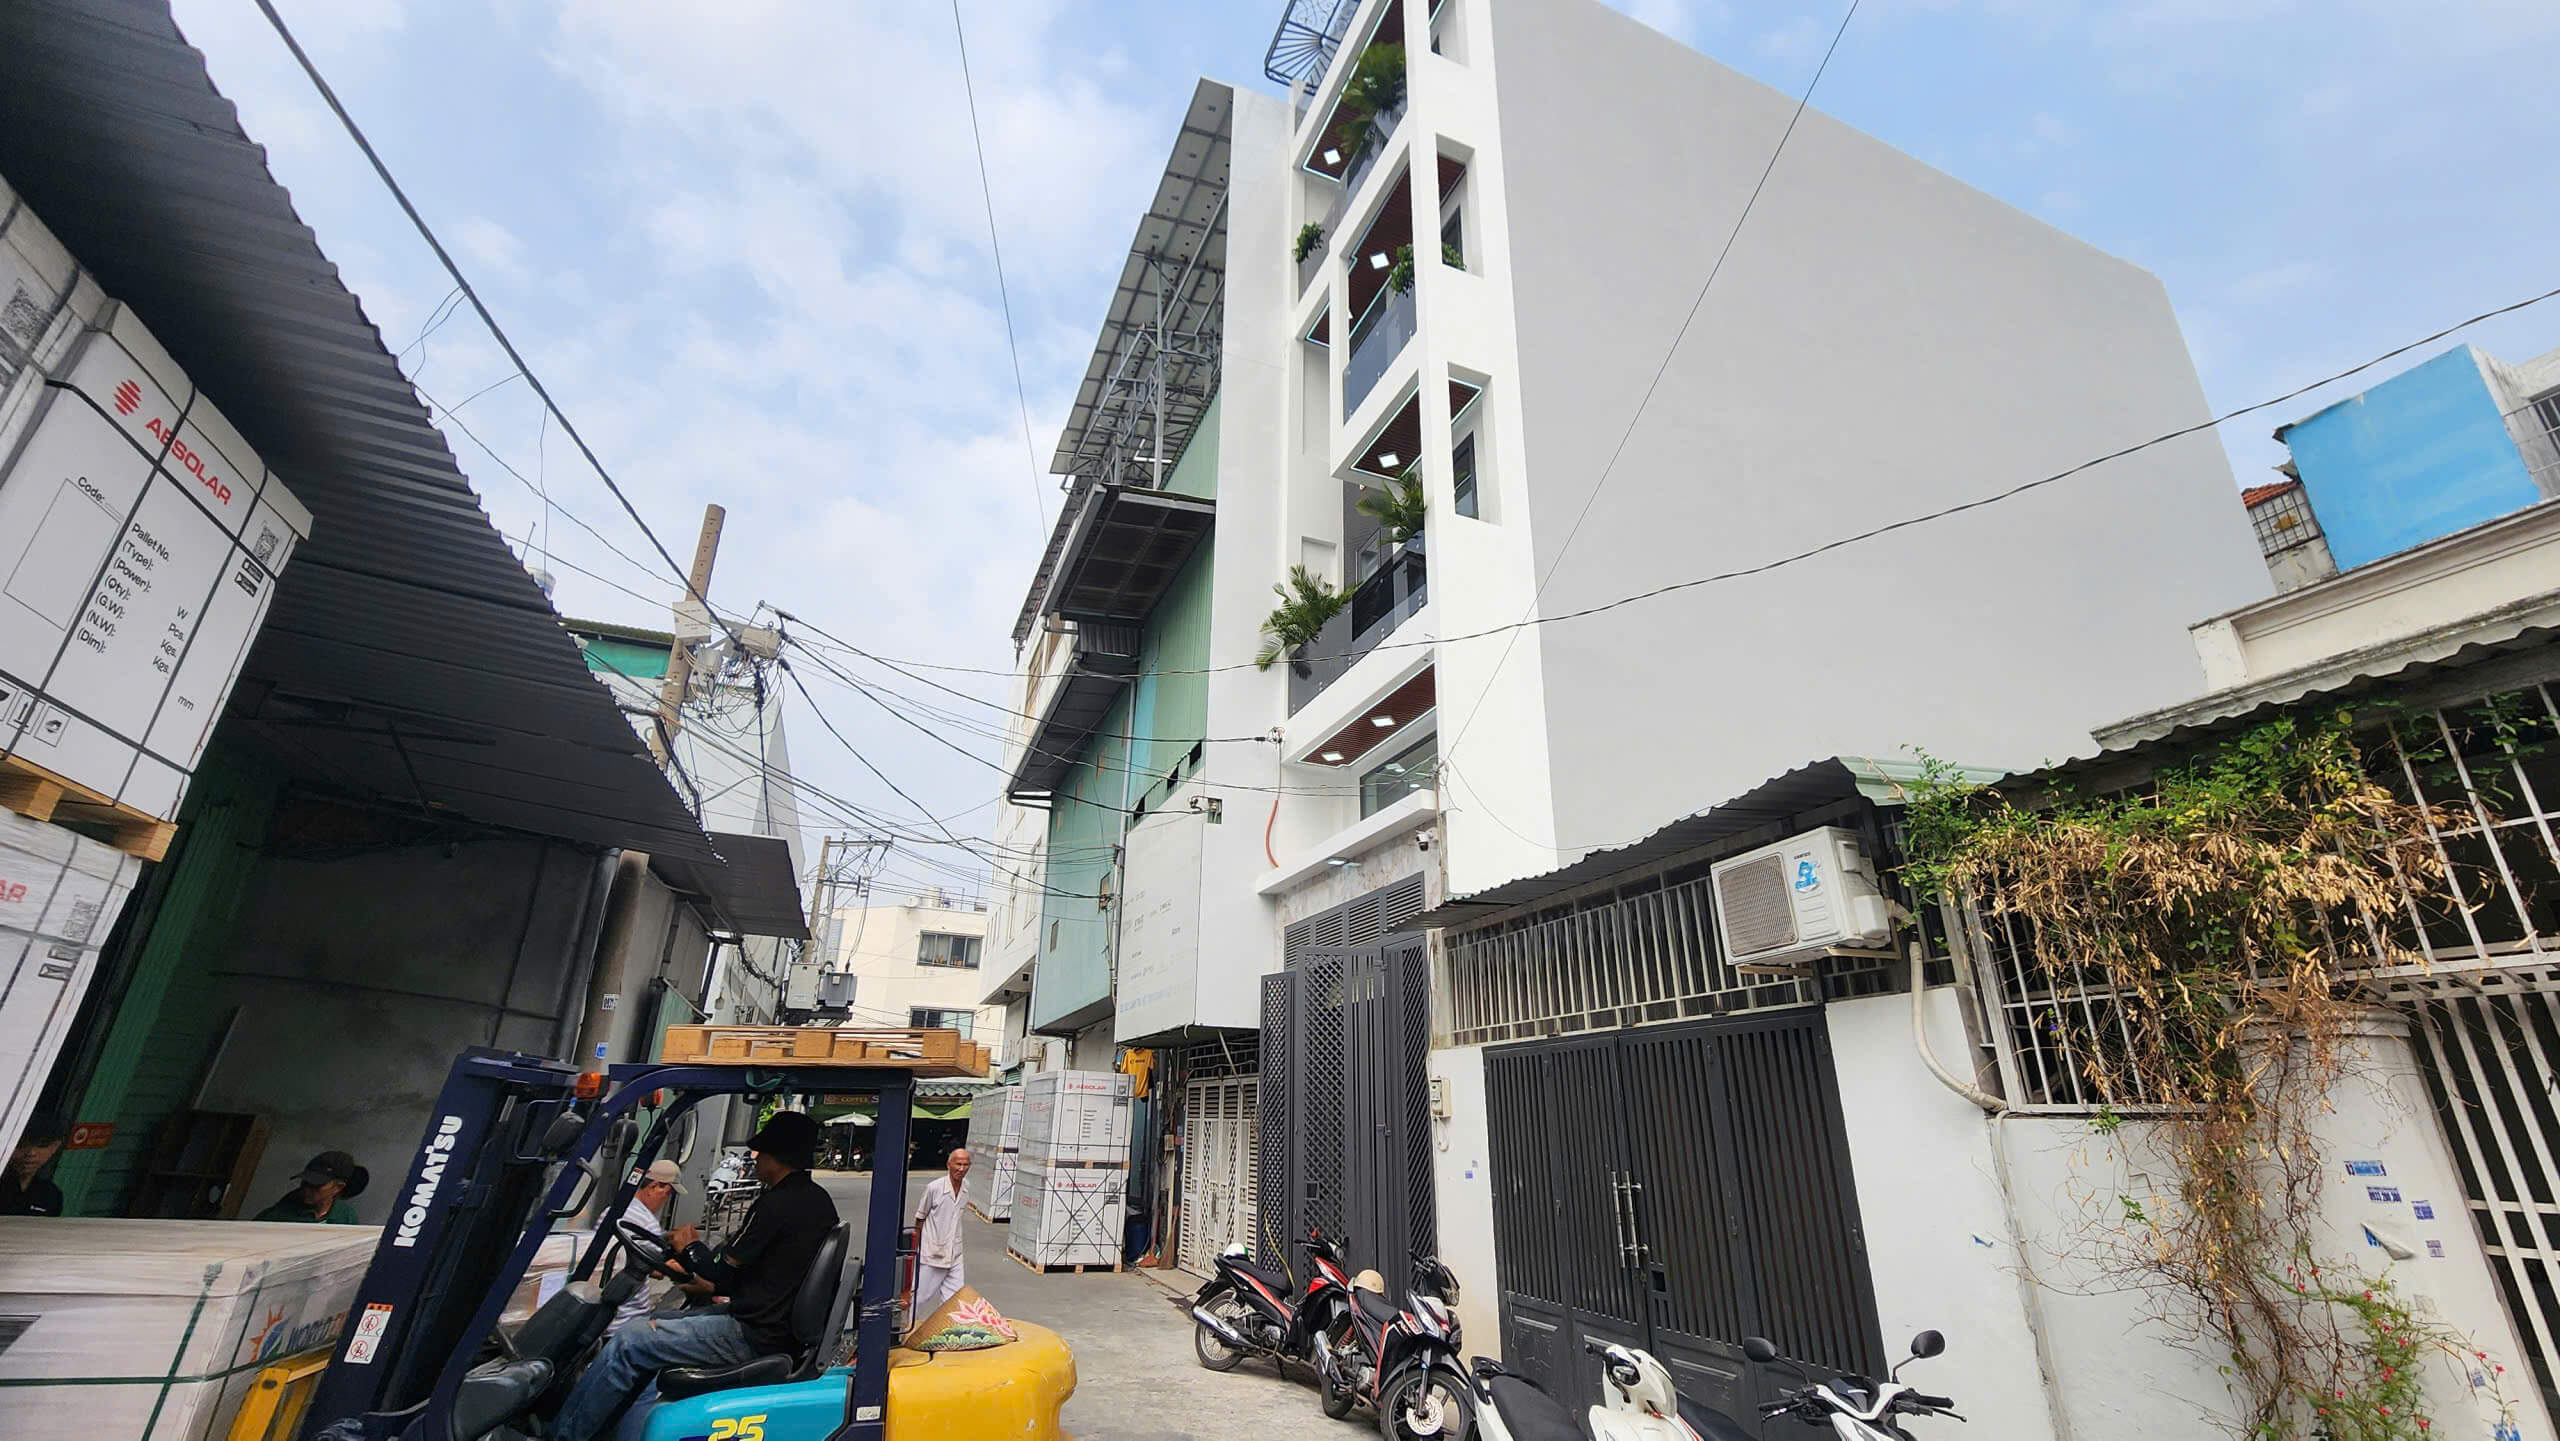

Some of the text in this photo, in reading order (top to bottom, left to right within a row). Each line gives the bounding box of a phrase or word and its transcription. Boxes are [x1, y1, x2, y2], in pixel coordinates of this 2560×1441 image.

[77, 476, 105, 504] Code:
[131, 523, 158, 550] Pallet
[122, 540, 154, 570] (Type):
[104, 574, 131, 600] (Qty):
[113, 557, 189, 620] (Power): W
[77, 628, 195, 711] (Dim): mm
[393, 1115, 462, 1247] KOMATSU
[707, 1414, 768, 1441] 25
